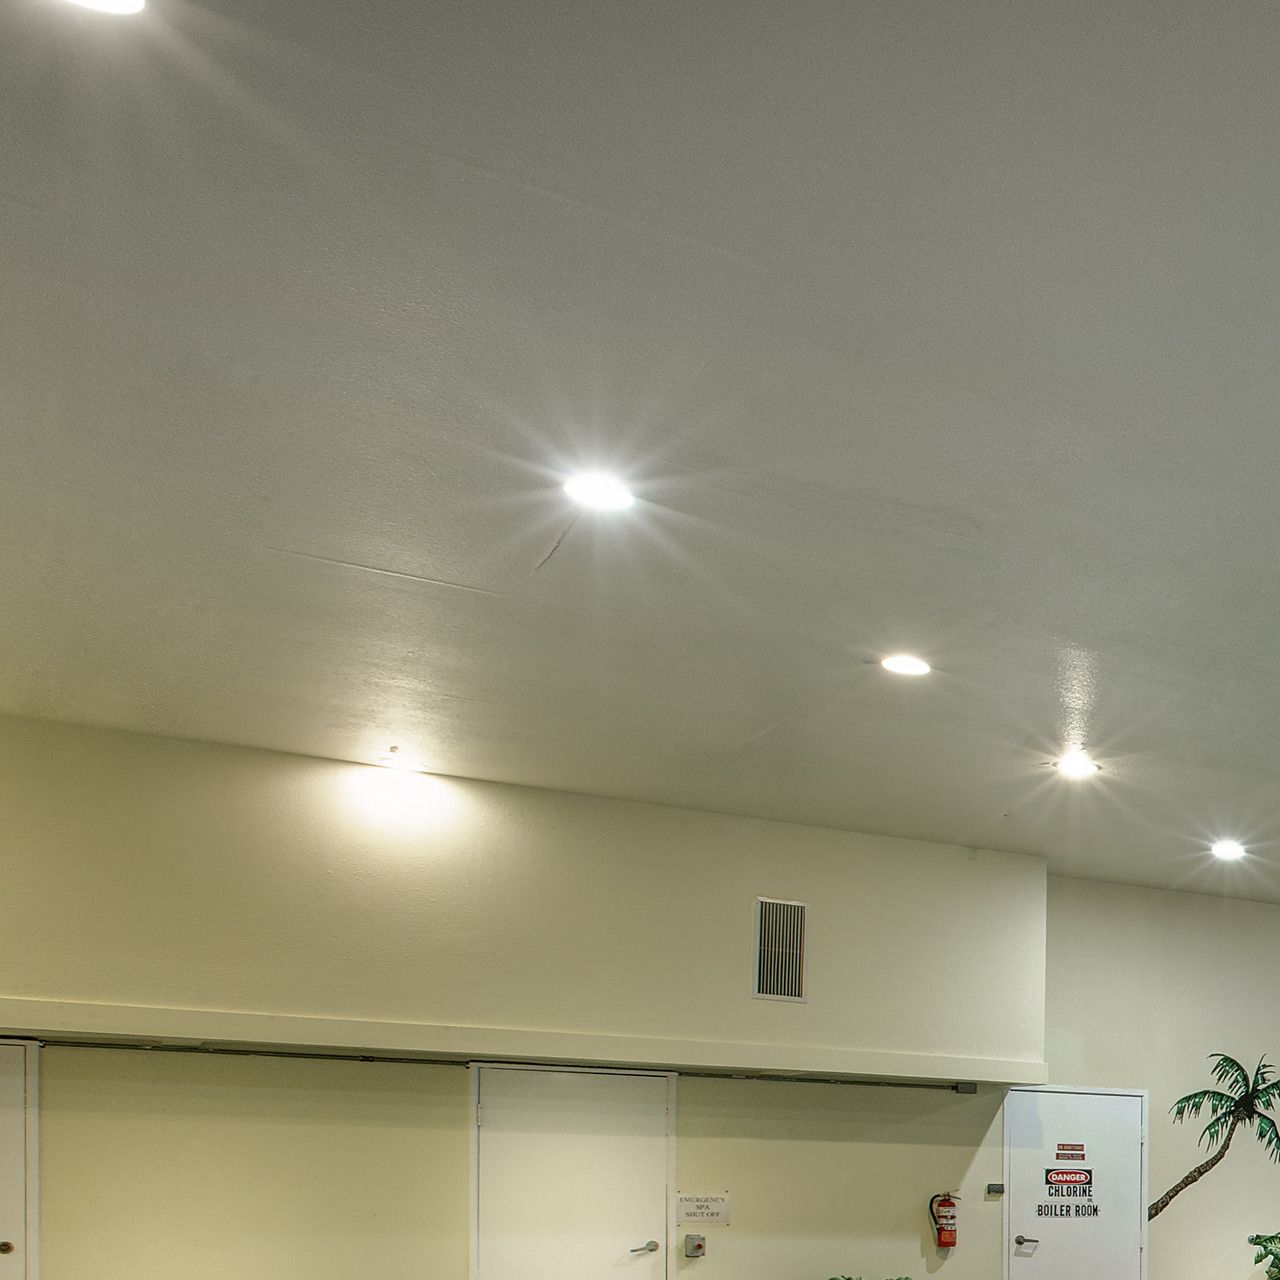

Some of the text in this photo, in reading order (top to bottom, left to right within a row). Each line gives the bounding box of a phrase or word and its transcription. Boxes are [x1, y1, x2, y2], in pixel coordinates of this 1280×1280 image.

[1051, 1173, 1086, 1181] DANGER
[1048, 1185, 1093, 1198] CHLORINE
[1037, 1204, 1099, 1217] BOILER ROOM
